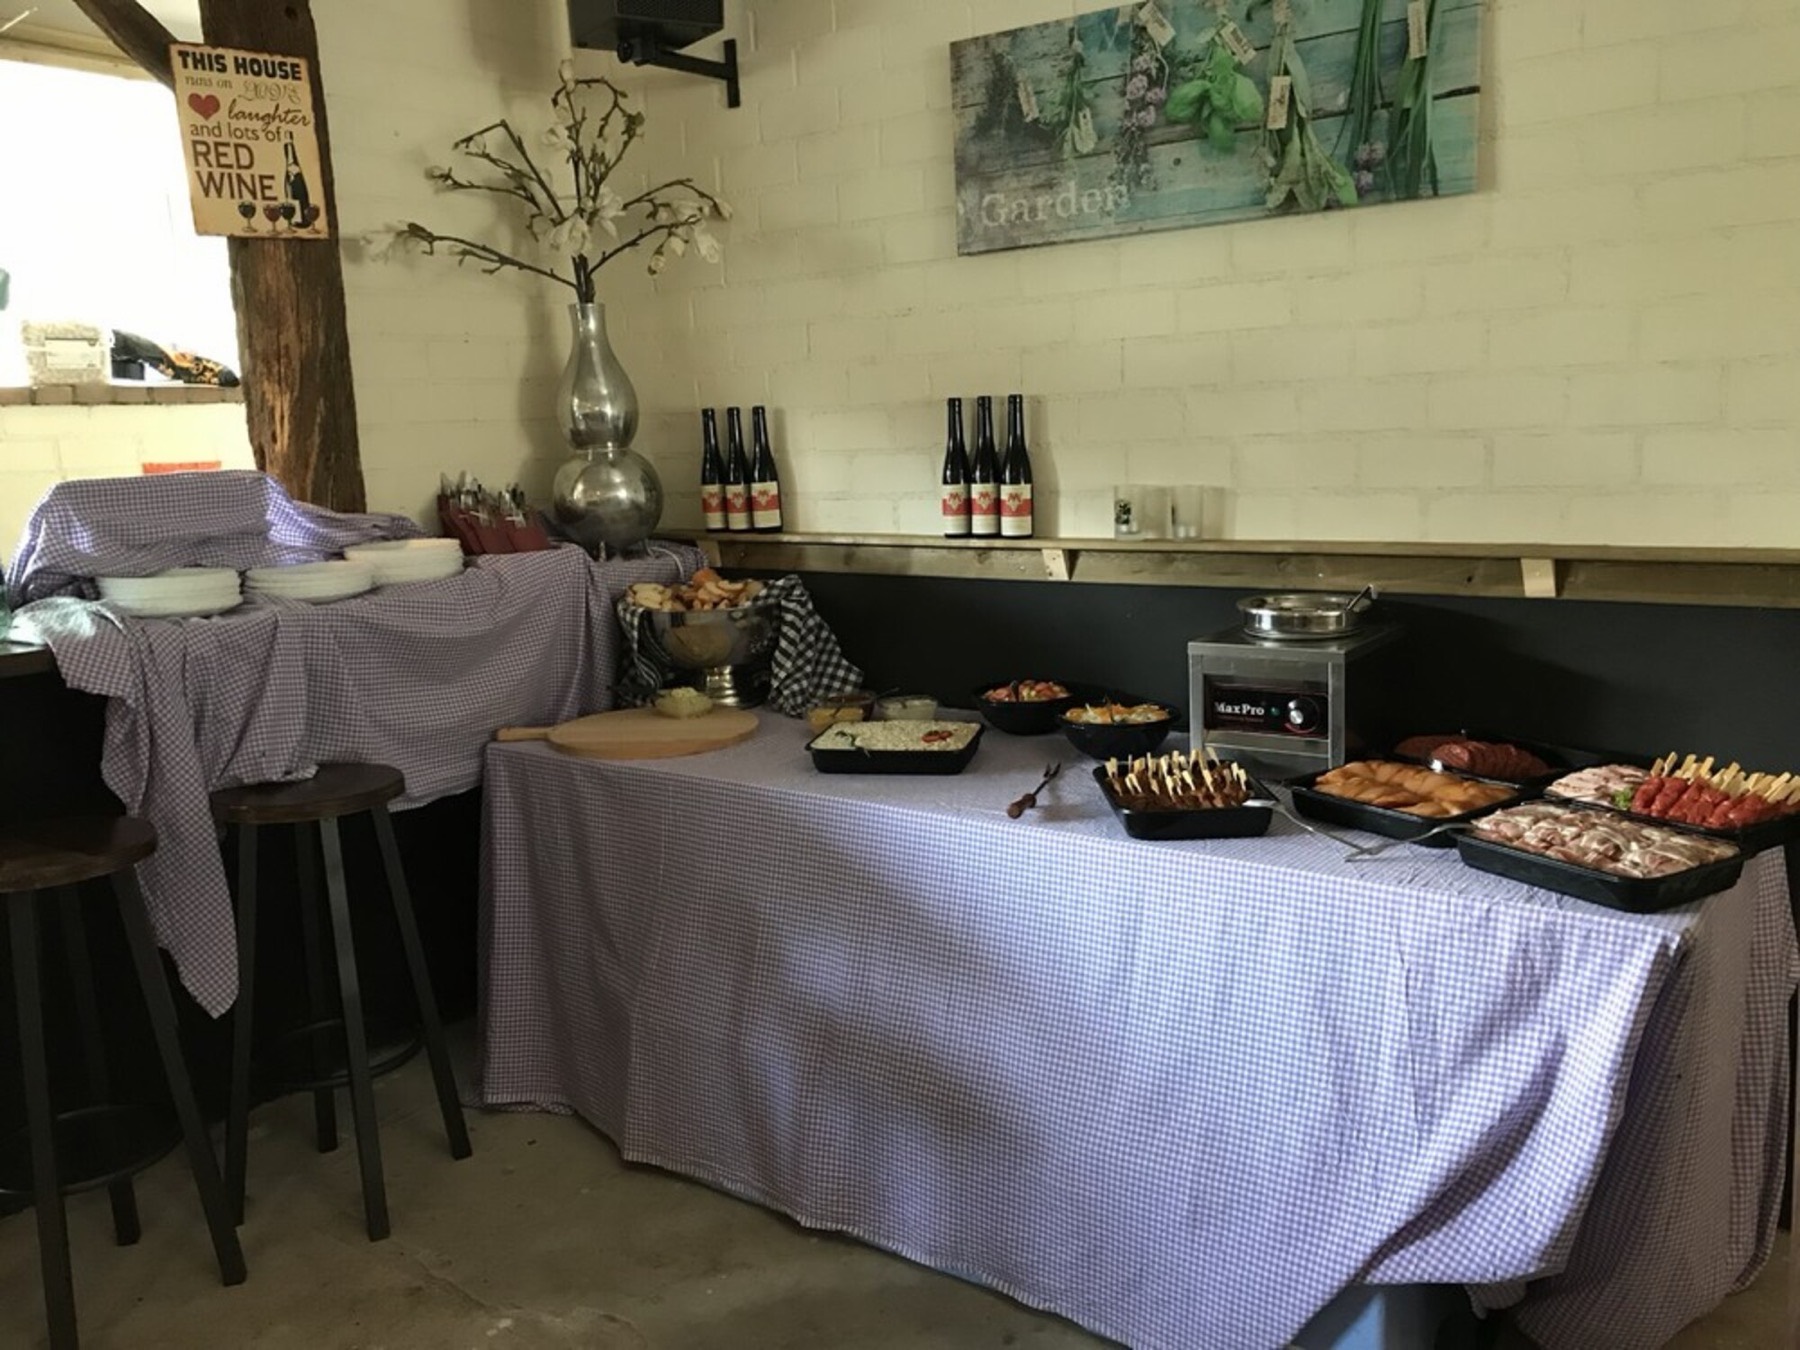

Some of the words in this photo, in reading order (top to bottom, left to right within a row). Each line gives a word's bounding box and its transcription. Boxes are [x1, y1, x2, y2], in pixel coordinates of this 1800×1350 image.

[178, 50, 227, 73] THIS
[234, 56, 302, 81] HOUSE
[185, 75, 213, 88] runs
[217, 79, 233, 89] on
[228, 98, 310, 132] laughter
[190, 122, 222, 138] and
[228, 123, 260, 141] lots
[265, 126, 282, 142] of
[191, 140, 254, 170] RED
[195, 170, 278, 201] WINE
[981, 180, 1131, 228] Garden
